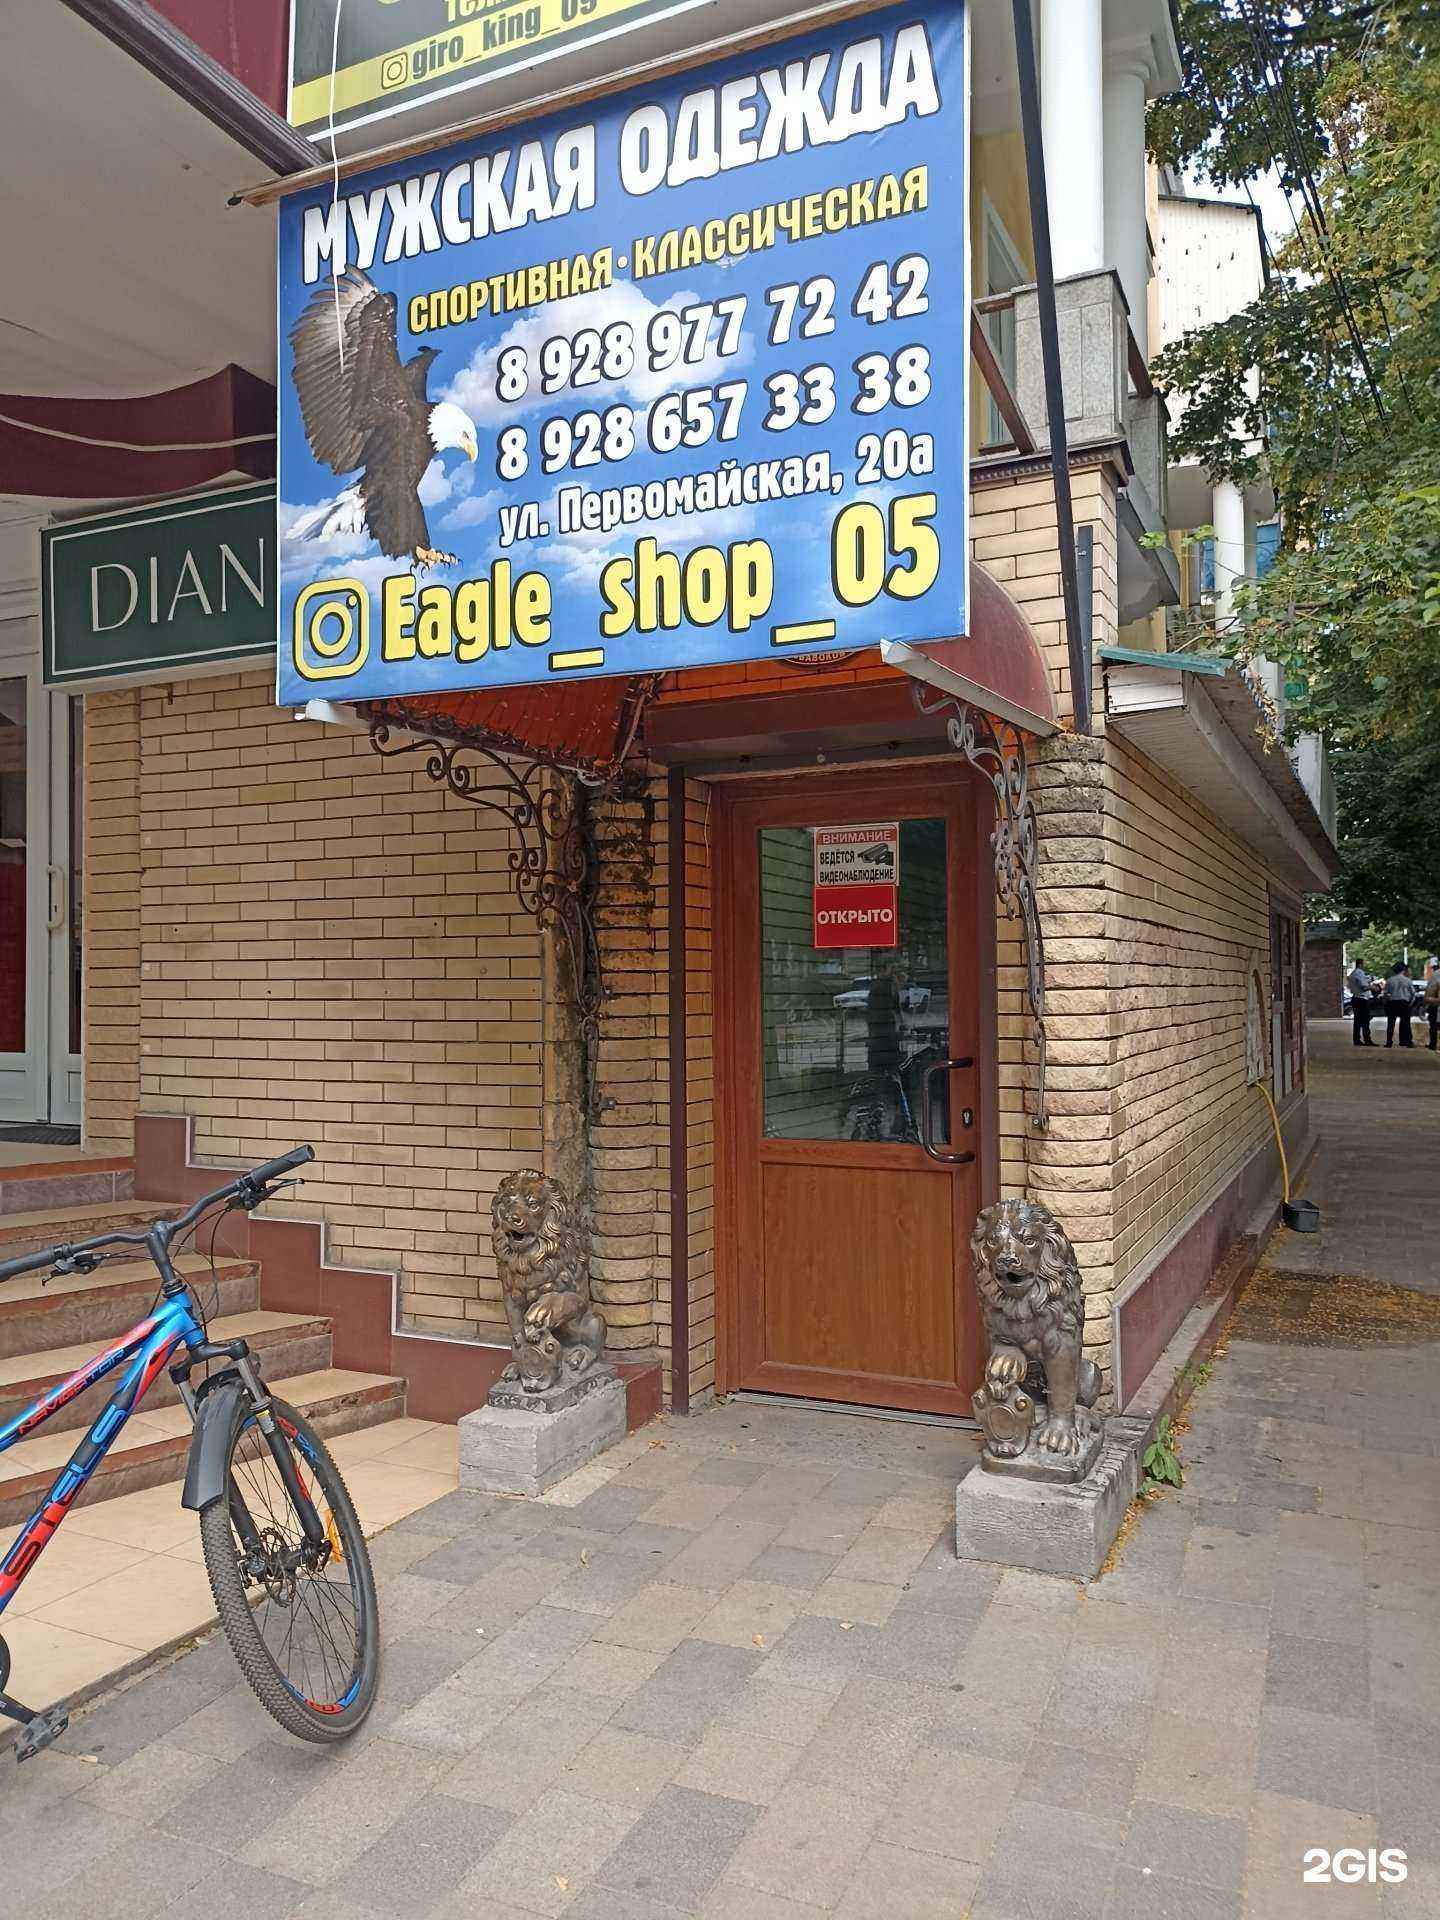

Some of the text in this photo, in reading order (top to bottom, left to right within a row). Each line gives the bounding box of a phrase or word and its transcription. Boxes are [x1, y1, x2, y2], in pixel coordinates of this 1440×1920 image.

[302, 22, 942, 284] МУЖСКАЯ ОДЕЖДА
[407, 164, 930, 333] СПОРТИВНАЯ КЛАССИЧЕСКАЯ
[497, 252, 930, 402] 8 928 977 72 42
[497, 344, 932, 481] 8 928 657 33 38
[499, 430, 934, 547] ул. Первомайская, 20а
[820, 868, 894, 884] ВИДЕОНАБЛЮДЕНИЕ
[822, 830, 892, 844] ВНИМАНИЕ
[817, 908, 893, 925] ОТКРЫТО
